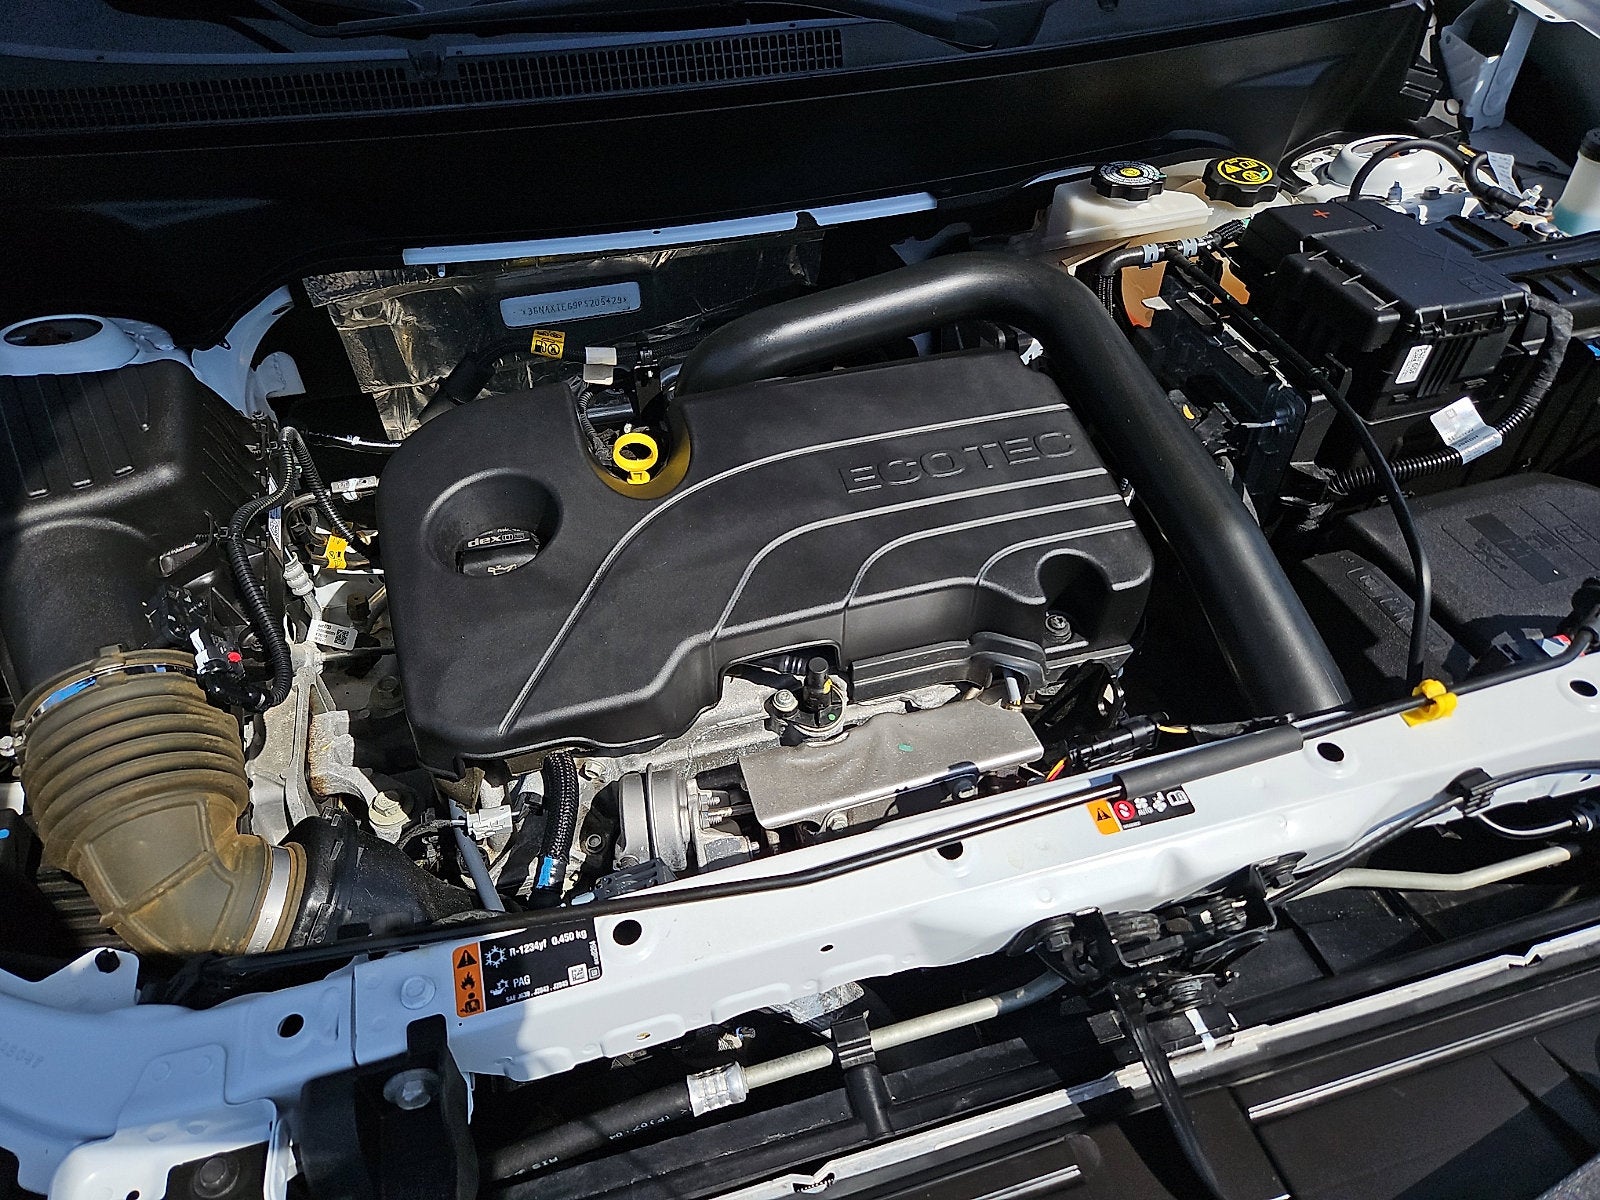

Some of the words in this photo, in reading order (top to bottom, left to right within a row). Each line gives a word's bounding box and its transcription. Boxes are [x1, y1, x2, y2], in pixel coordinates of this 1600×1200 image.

[839, 431, 1077, 494] ECOTEC
[509, 939, 547, 957] R-1234yf
[551, 931, 574, 946] 0.450
[574, 928, 588, 941] kg
[513, 974, 531, 989] PAG
